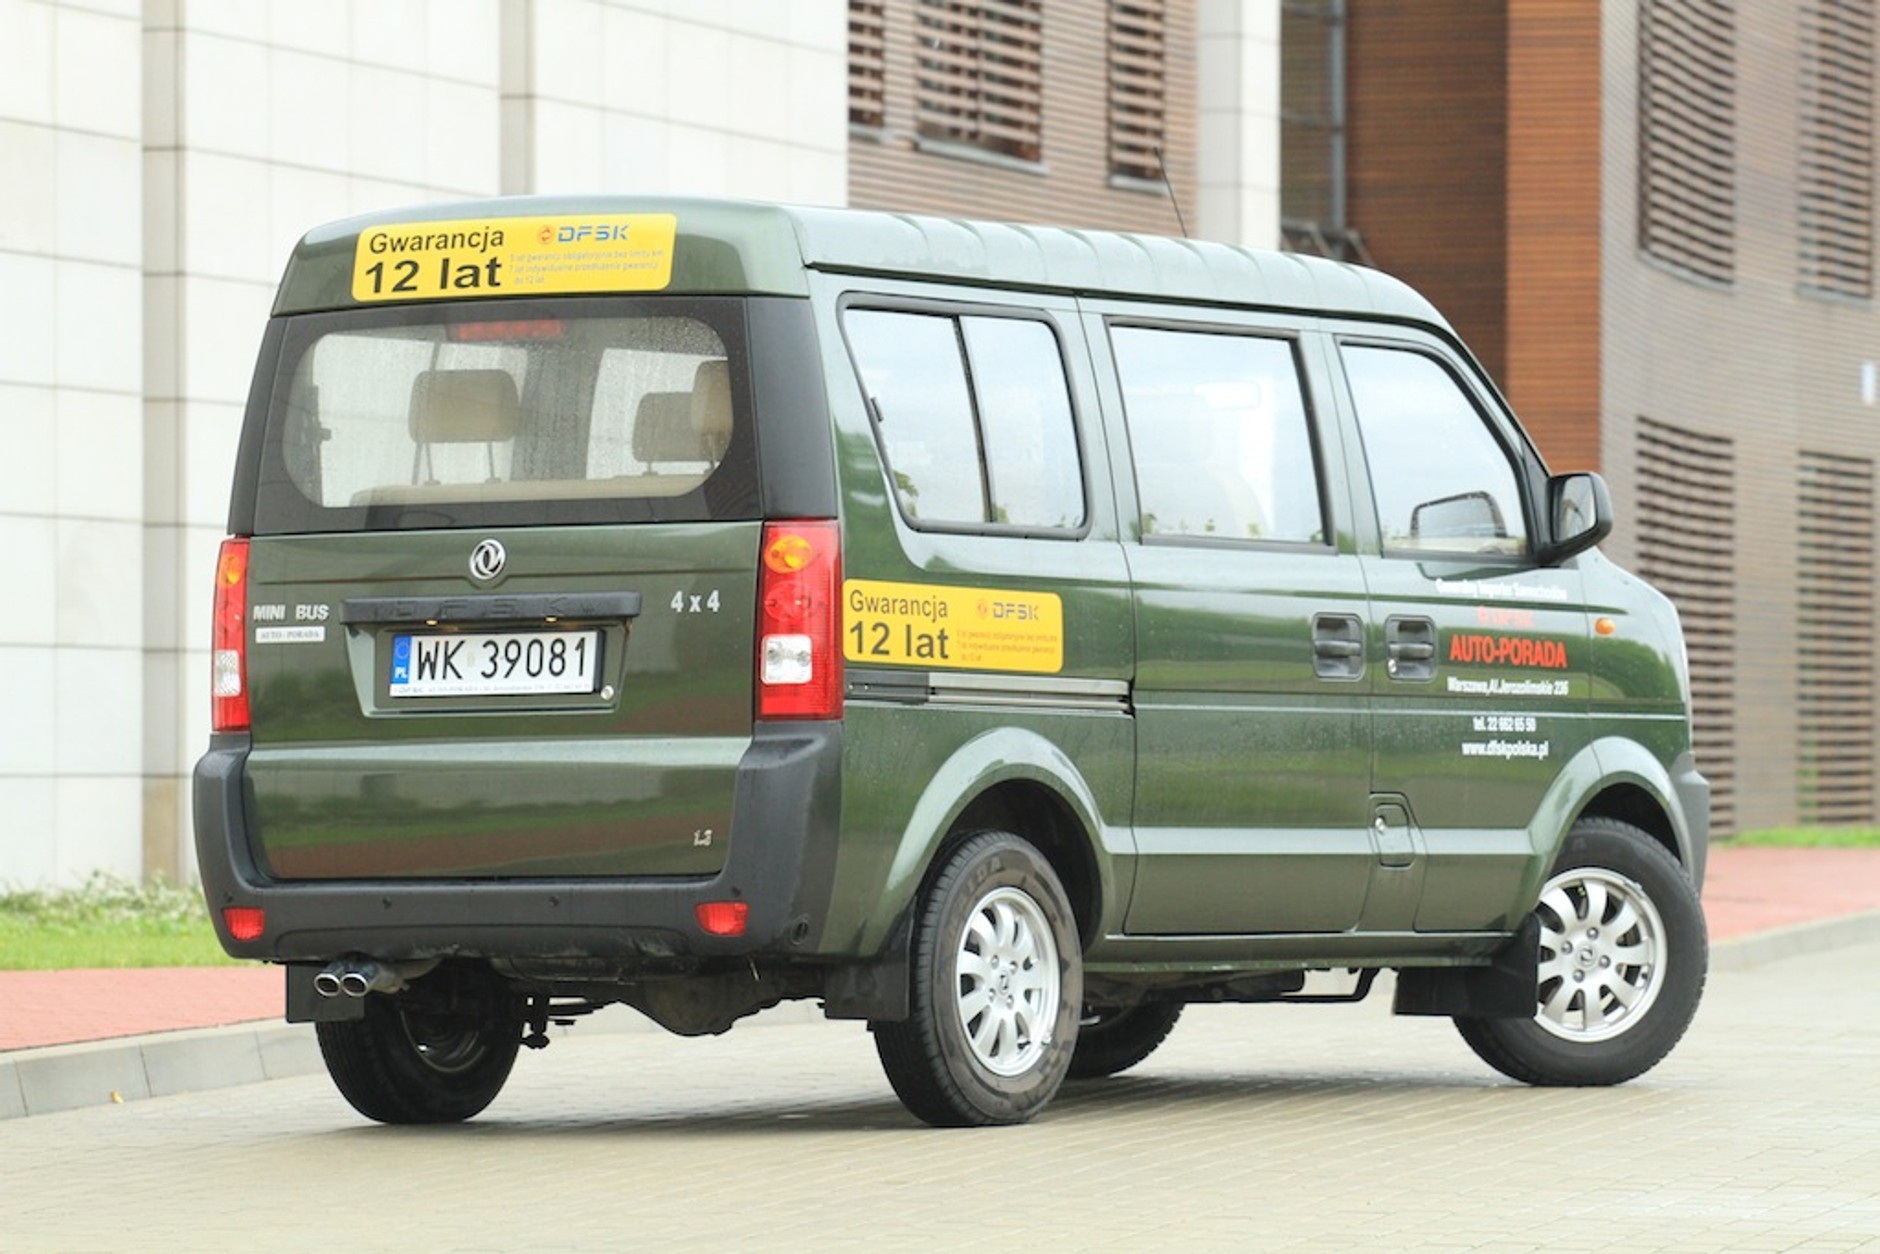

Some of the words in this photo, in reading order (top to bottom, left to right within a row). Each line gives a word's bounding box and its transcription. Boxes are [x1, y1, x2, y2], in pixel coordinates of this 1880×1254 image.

[369, 226, 505, 255] Gwarancja
[557, 224, 630, 243] DFSK
[364, 259, 421, 294] 12
[439, 256, 503, 290] lat
[253, 604, 286, 621] MINI
[295, 603, 330, 620] BUS
[849, 589, 949, 624] Gwarancja
[992, 601, 1040, 621] DFSK
[849, 620, 891, 656] 12
[905, 623, 950, 660] lat
[1449, 634, 1568, 669] AUTO-PORADA
[394, 666, 408, 679] PL
[417, 640, 466, 681] WK
[480, 637, 587, 680] 39081
